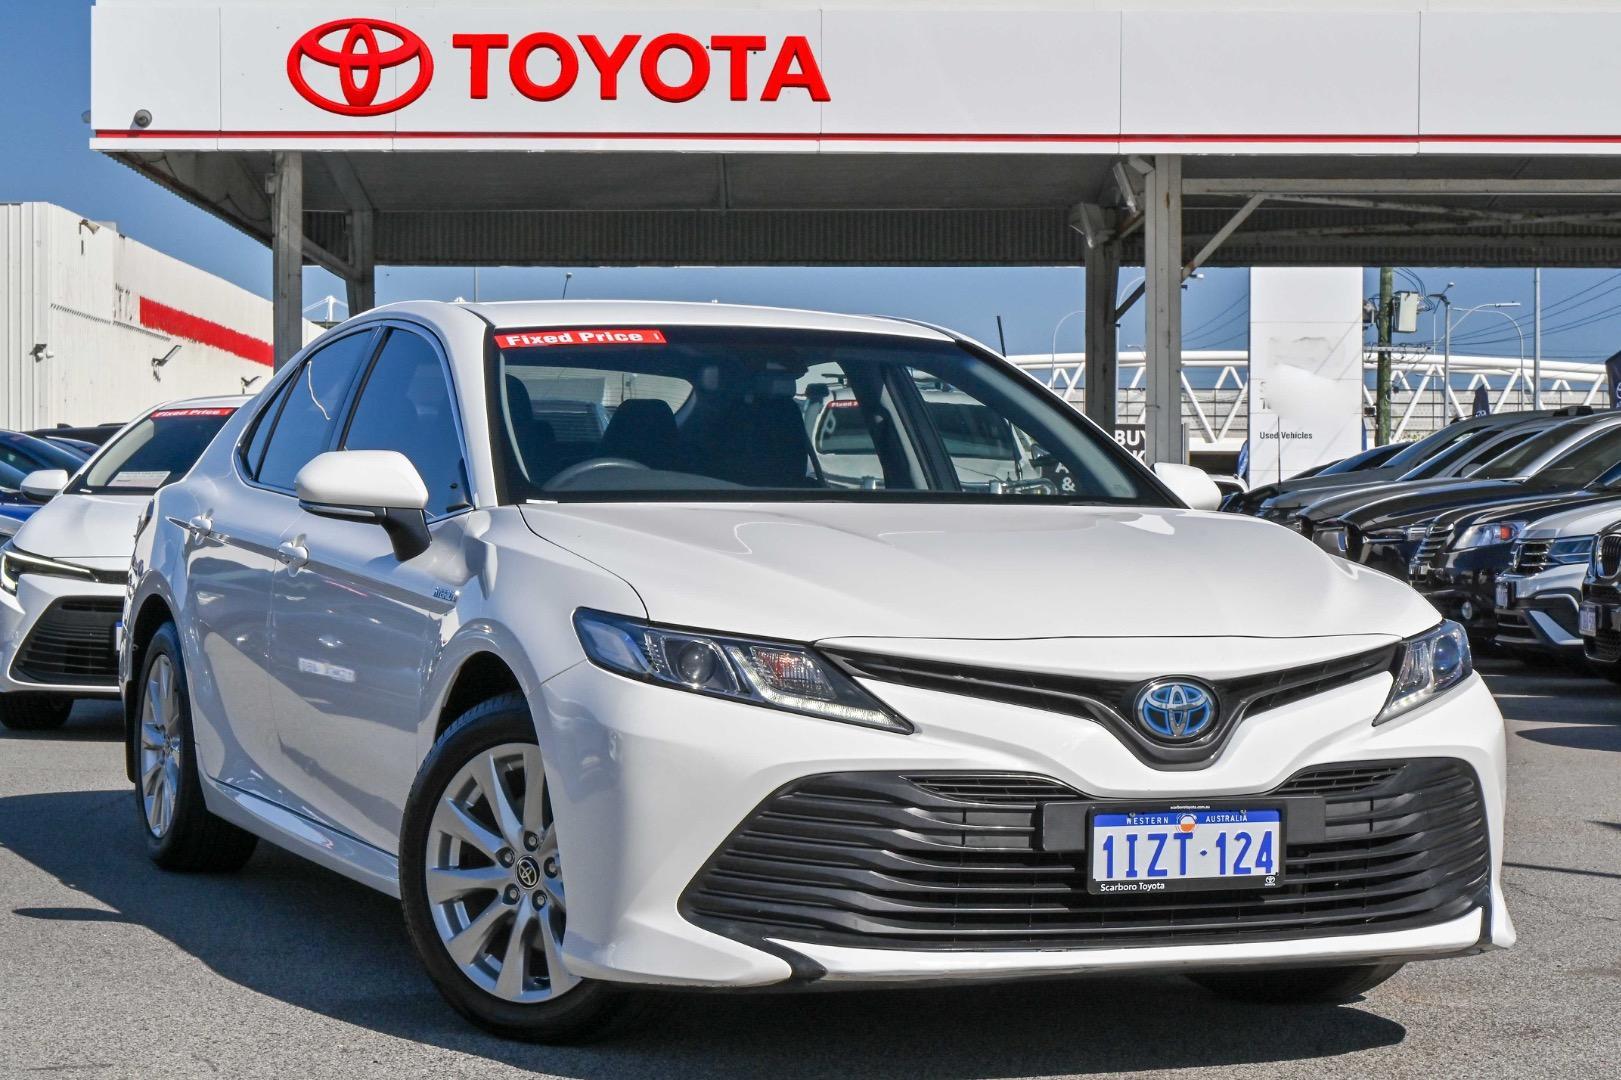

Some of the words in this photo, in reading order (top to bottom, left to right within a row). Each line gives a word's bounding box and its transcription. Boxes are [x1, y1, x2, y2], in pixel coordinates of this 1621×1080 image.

[452, 32, 831, 102] TOYOTA
[506, 332, 573, 346] Fixed
[578, 331, 643, 343] Price
[1260, 431, 1279, 439] Used
[1281, 431, 1312, 439] Vehicles
[1126, 816, 1169, 825] WESTERN
[1205, 814, 1248, 823] AUSTRALIA
[1100, 883, 1137, 892] Scarboro
[1138, 882, 1165, 892] Toyota
